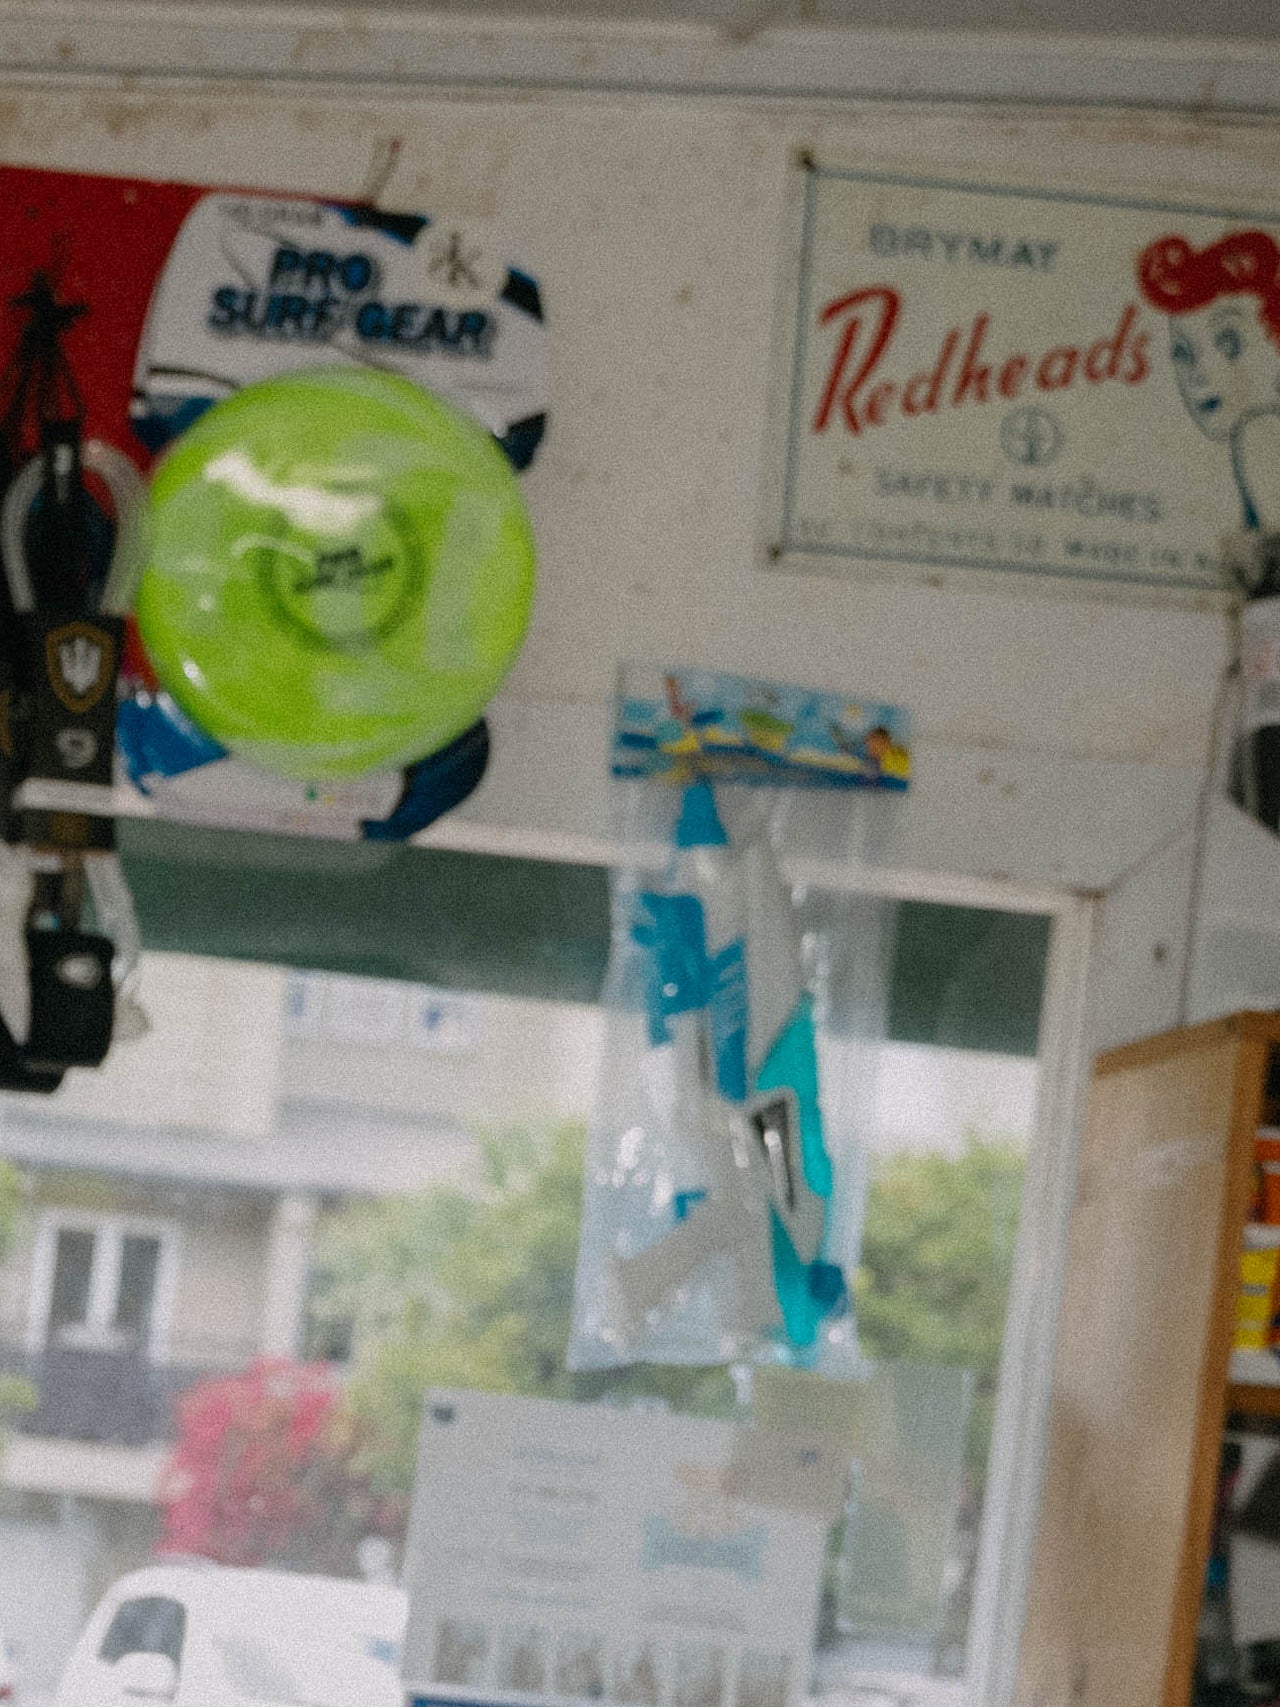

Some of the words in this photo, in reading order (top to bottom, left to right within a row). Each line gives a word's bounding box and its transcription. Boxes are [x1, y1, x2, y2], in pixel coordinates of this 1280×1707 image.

[269, 247, 378, 297] PRO
[870, 223, 1058, 273] BRYMAY
[206, 286, 342, 340] SURF
[353, 300, 493, 354] GEAR
[813, 283, 1152, 434] Redheads
[874, 465, 993, 500] SAFETY
[1012, 482, 1164, 524] MATCHES
